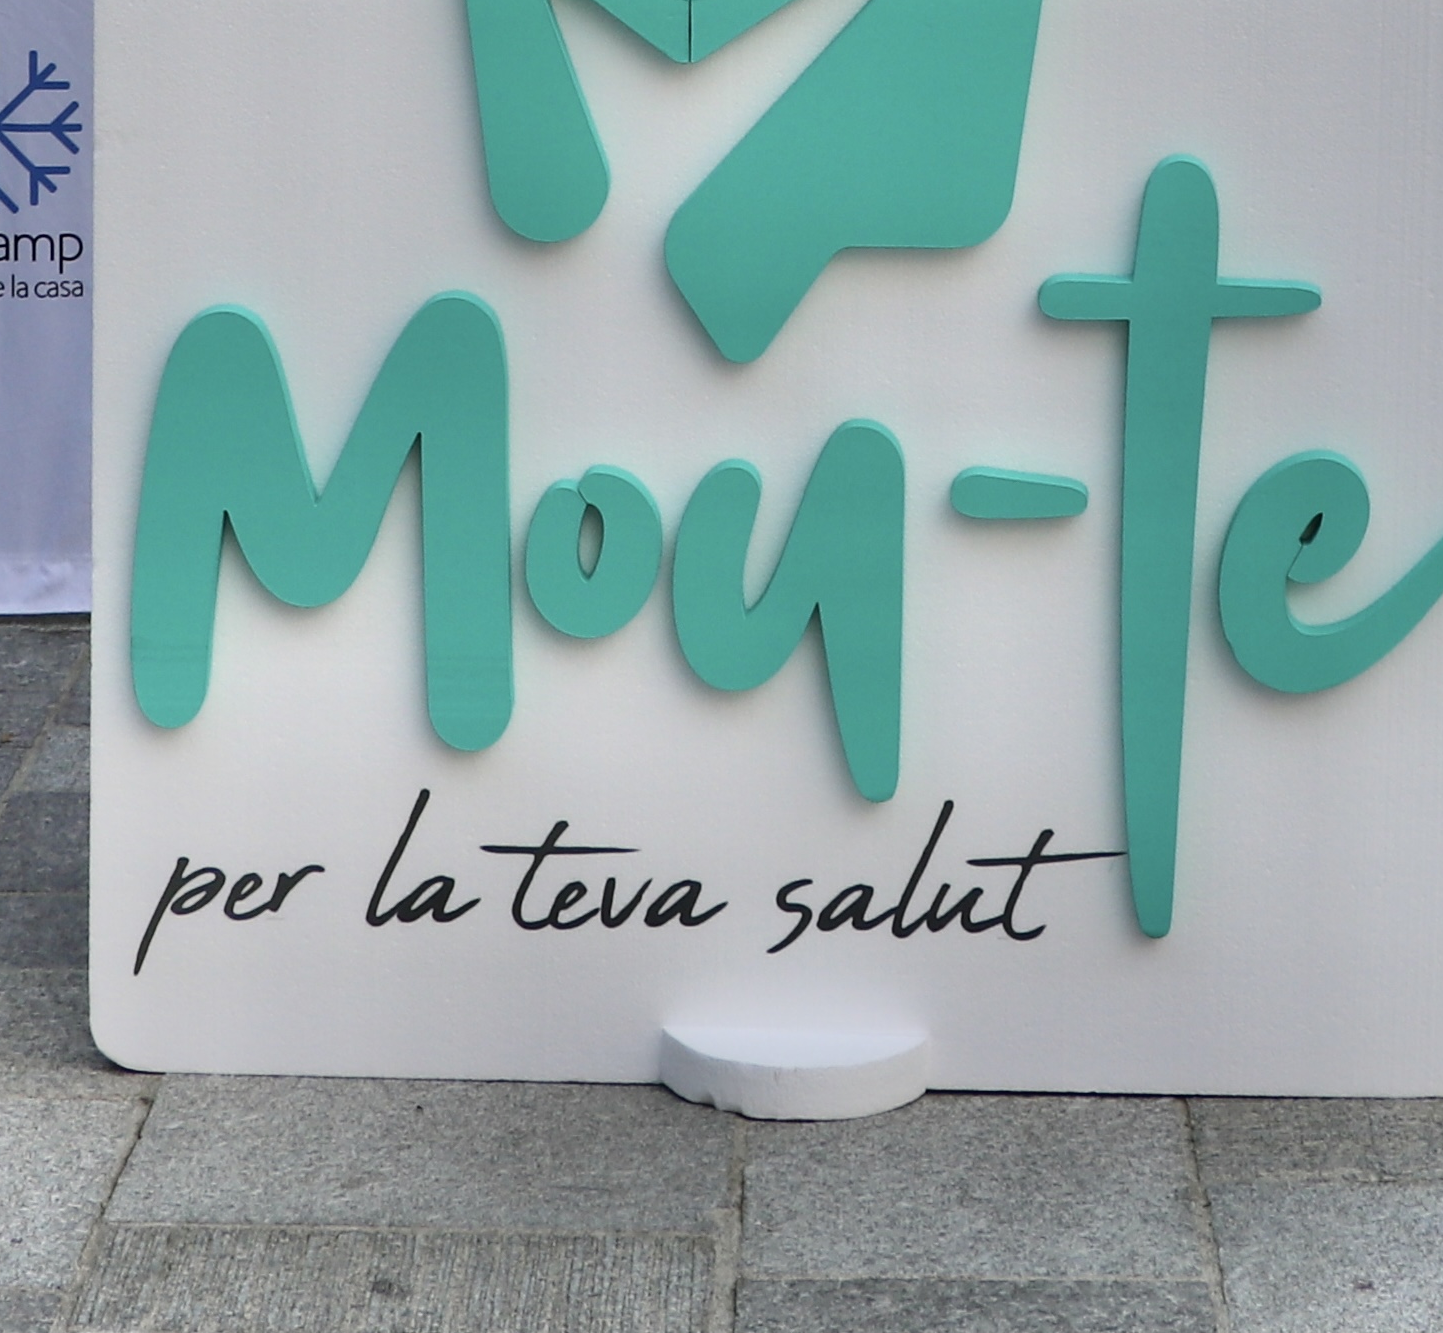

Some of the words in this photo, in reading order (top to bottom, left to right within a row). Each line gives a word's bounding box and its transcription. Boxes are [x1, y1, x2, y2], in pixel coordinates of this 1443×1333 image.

[11, 273, 29, 299] la
[33, 279, 84, 299] casa
[133, 856, 326, 976] per
[365, 787, 481, 927] la
[479, 820, 729, 931] teva
[765, 799, 1129, 954] salut
